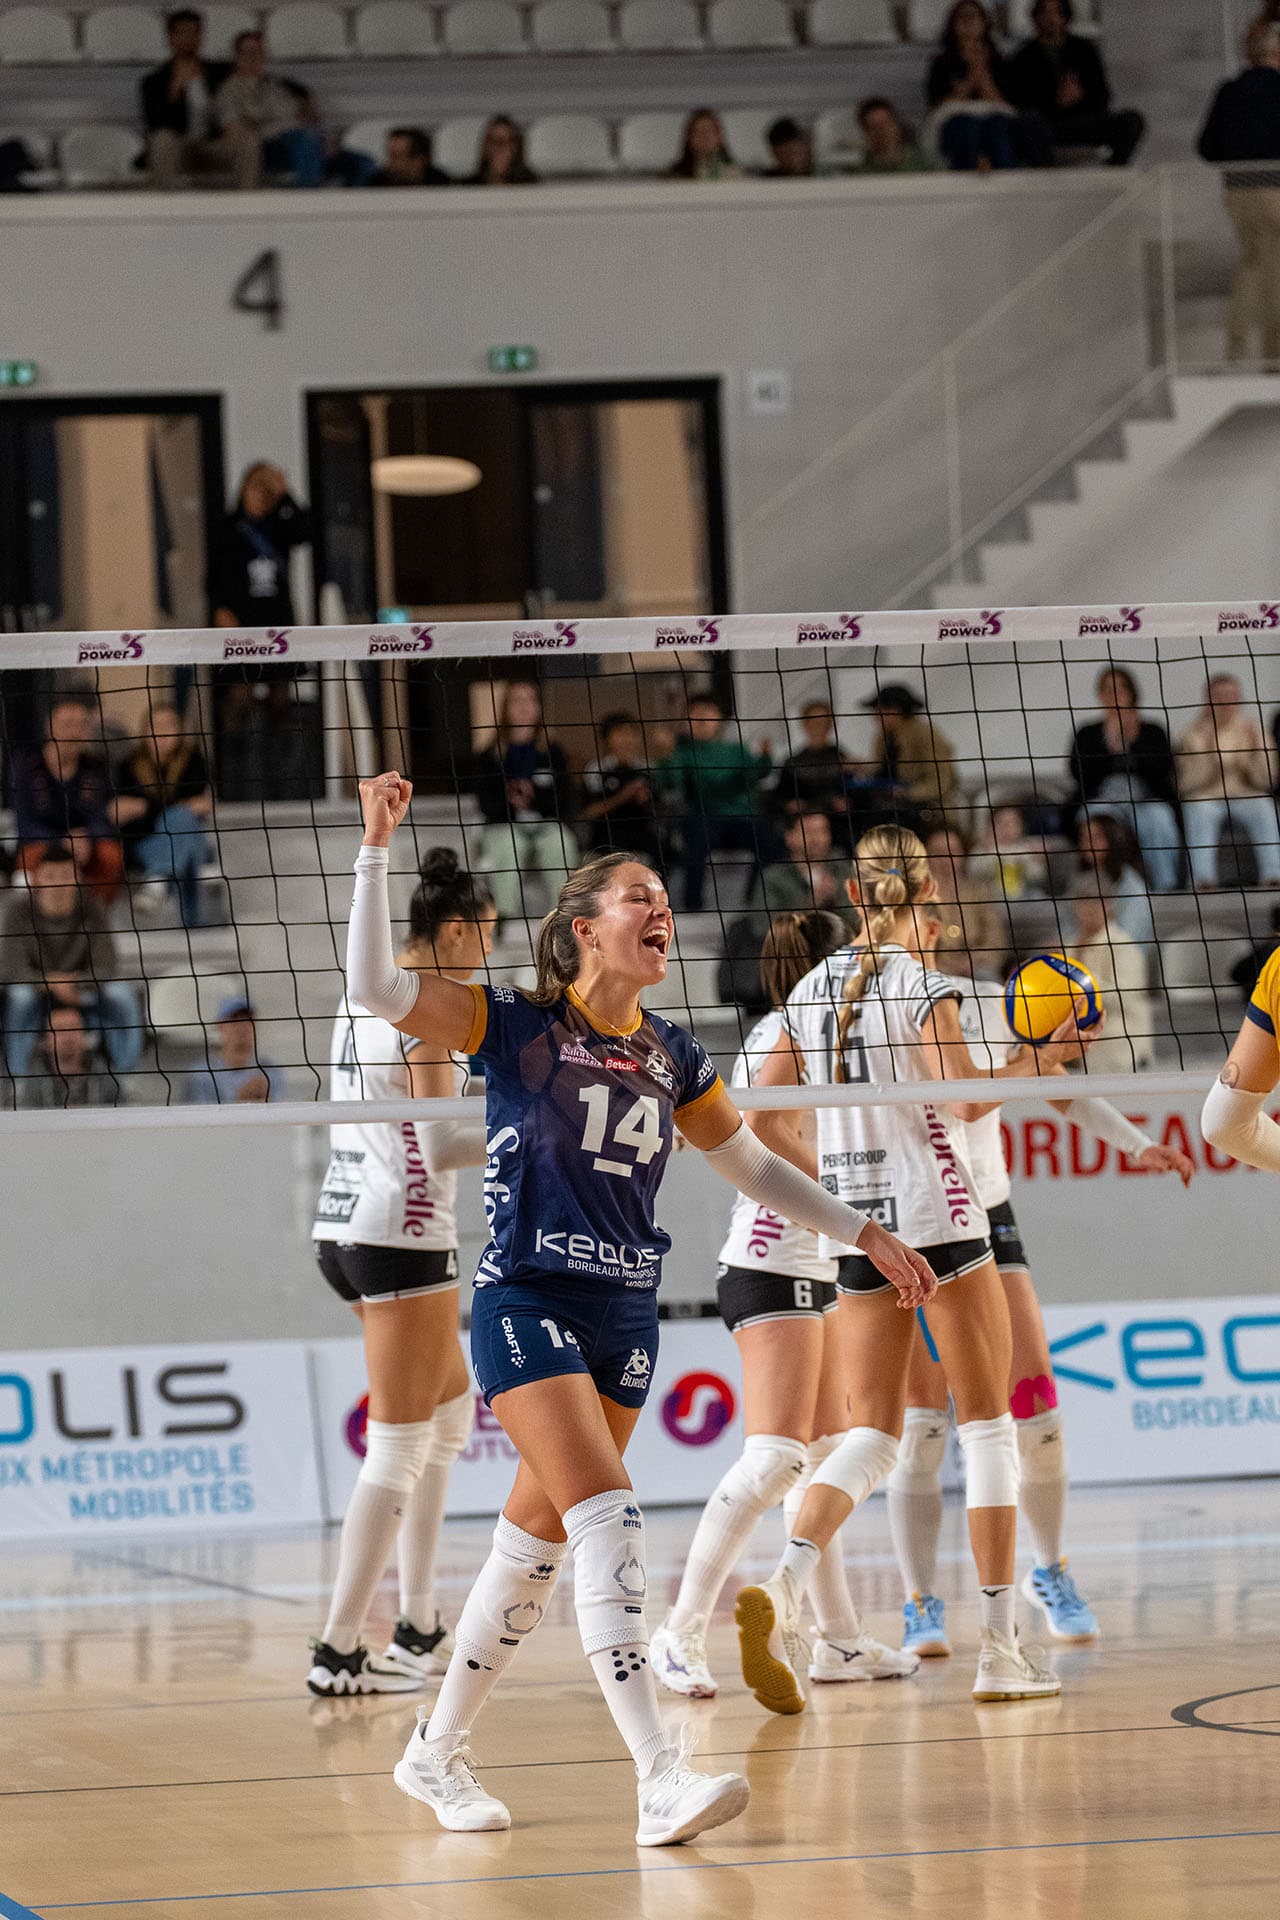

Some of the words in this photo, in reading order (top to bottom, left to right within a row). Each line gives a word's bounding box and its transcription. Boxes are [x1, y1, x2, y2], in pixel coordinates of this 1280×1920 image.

[232, 247, 286, 331] 4
[606, 1059, 638, 1071] Betclic
[578, 1083, 664, 1165] 14
[568, 1259, 620, 1277] BORDEAUX
[793, 1280, 813, 1308] 6
[501, 1317, 521, 1355] CRAFT
[41, 1443, 250, 1484] MÉTROPOLE
[70, 1480, 255, 1520] MOBILITÉS
